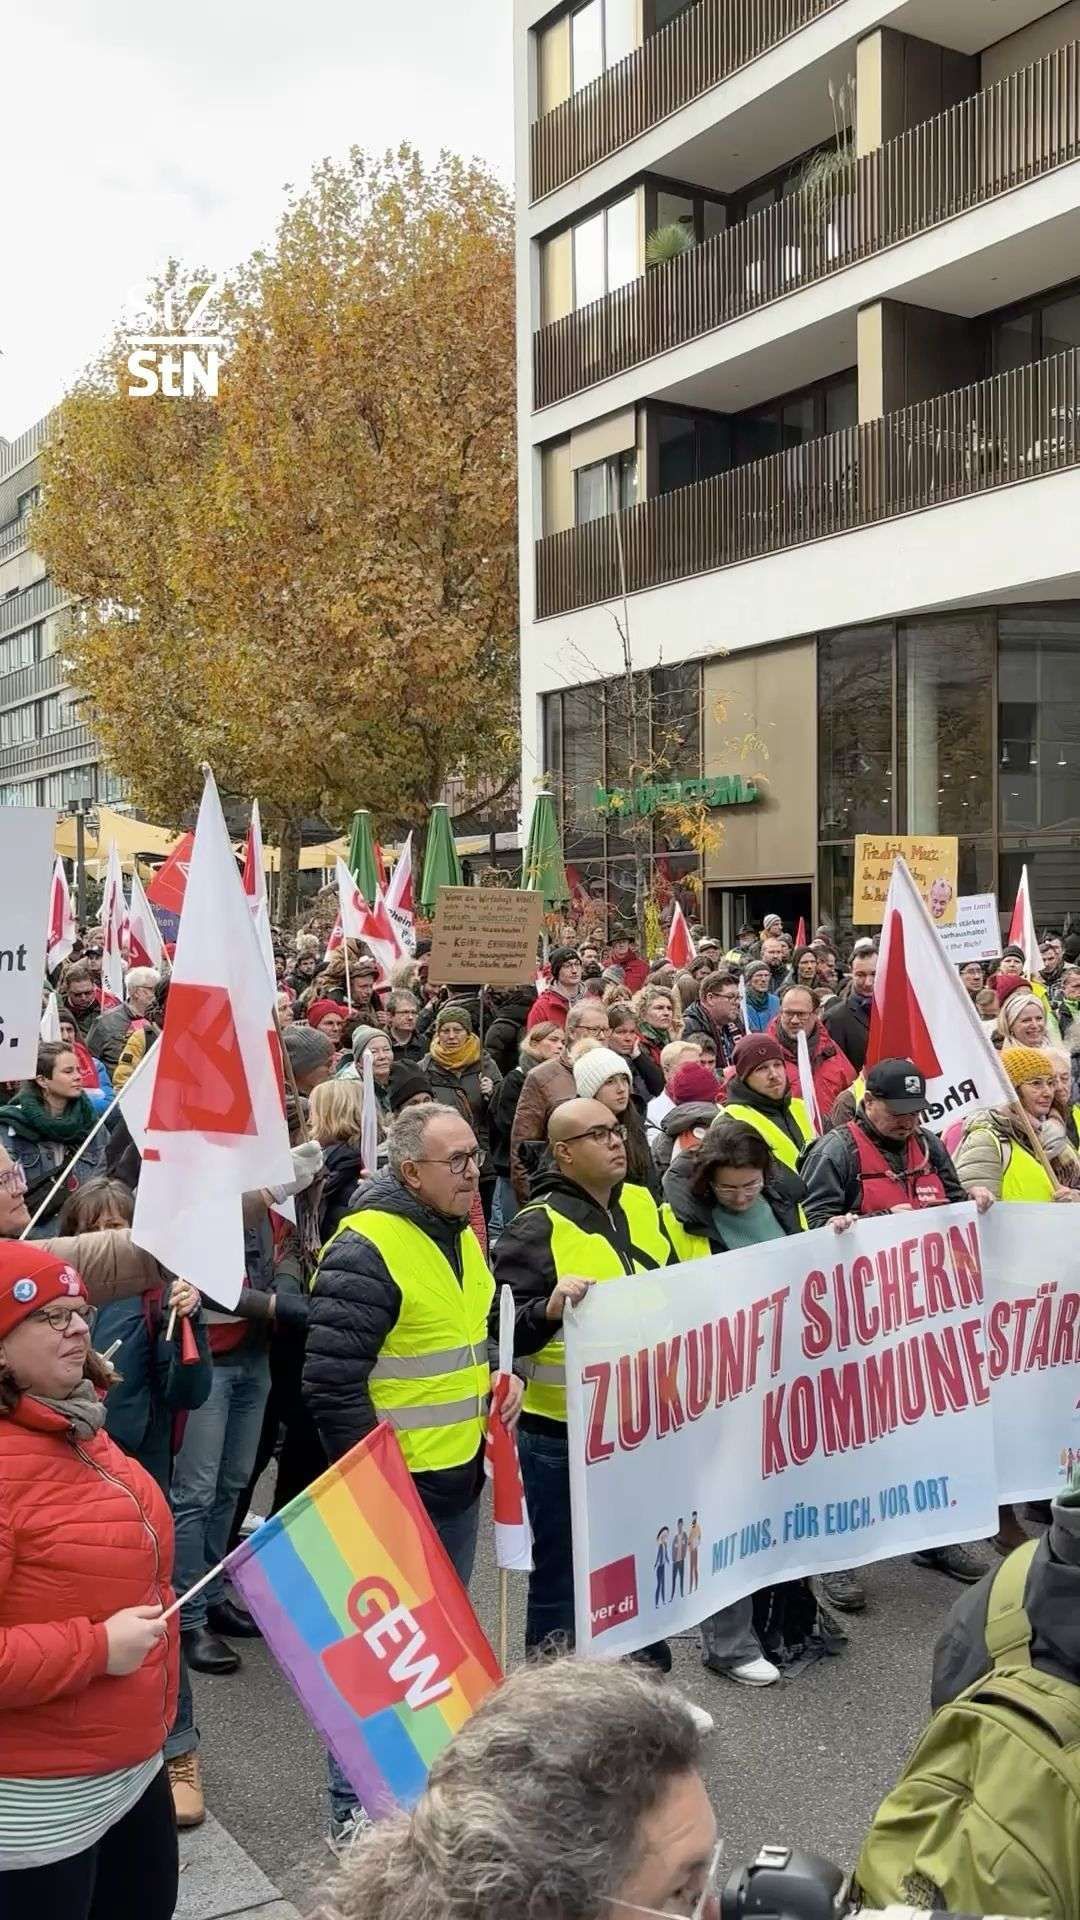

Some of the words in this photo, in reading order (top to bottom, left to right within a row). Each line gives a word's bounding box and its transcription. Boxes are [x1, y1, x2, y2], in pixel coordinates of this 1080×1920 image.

[582, 1286, 790, 1466] ZUKUNFT
[801, 1221, 985, 1360] SICHERN
[988, 1281, 1080, 1382] STÄR
[711, 1532, 738, 1576] MIT
[739, 1517, 777, 1559] UNS.
[783, 1502, 820, 1543] FÜR
[824, 1496, 875, 1534] EUCH.
[879, 1484, 910, 1521] VOR
[913, 1476, 958, 1512] ORT.
[347, 1576, 453, 1711] GEW
